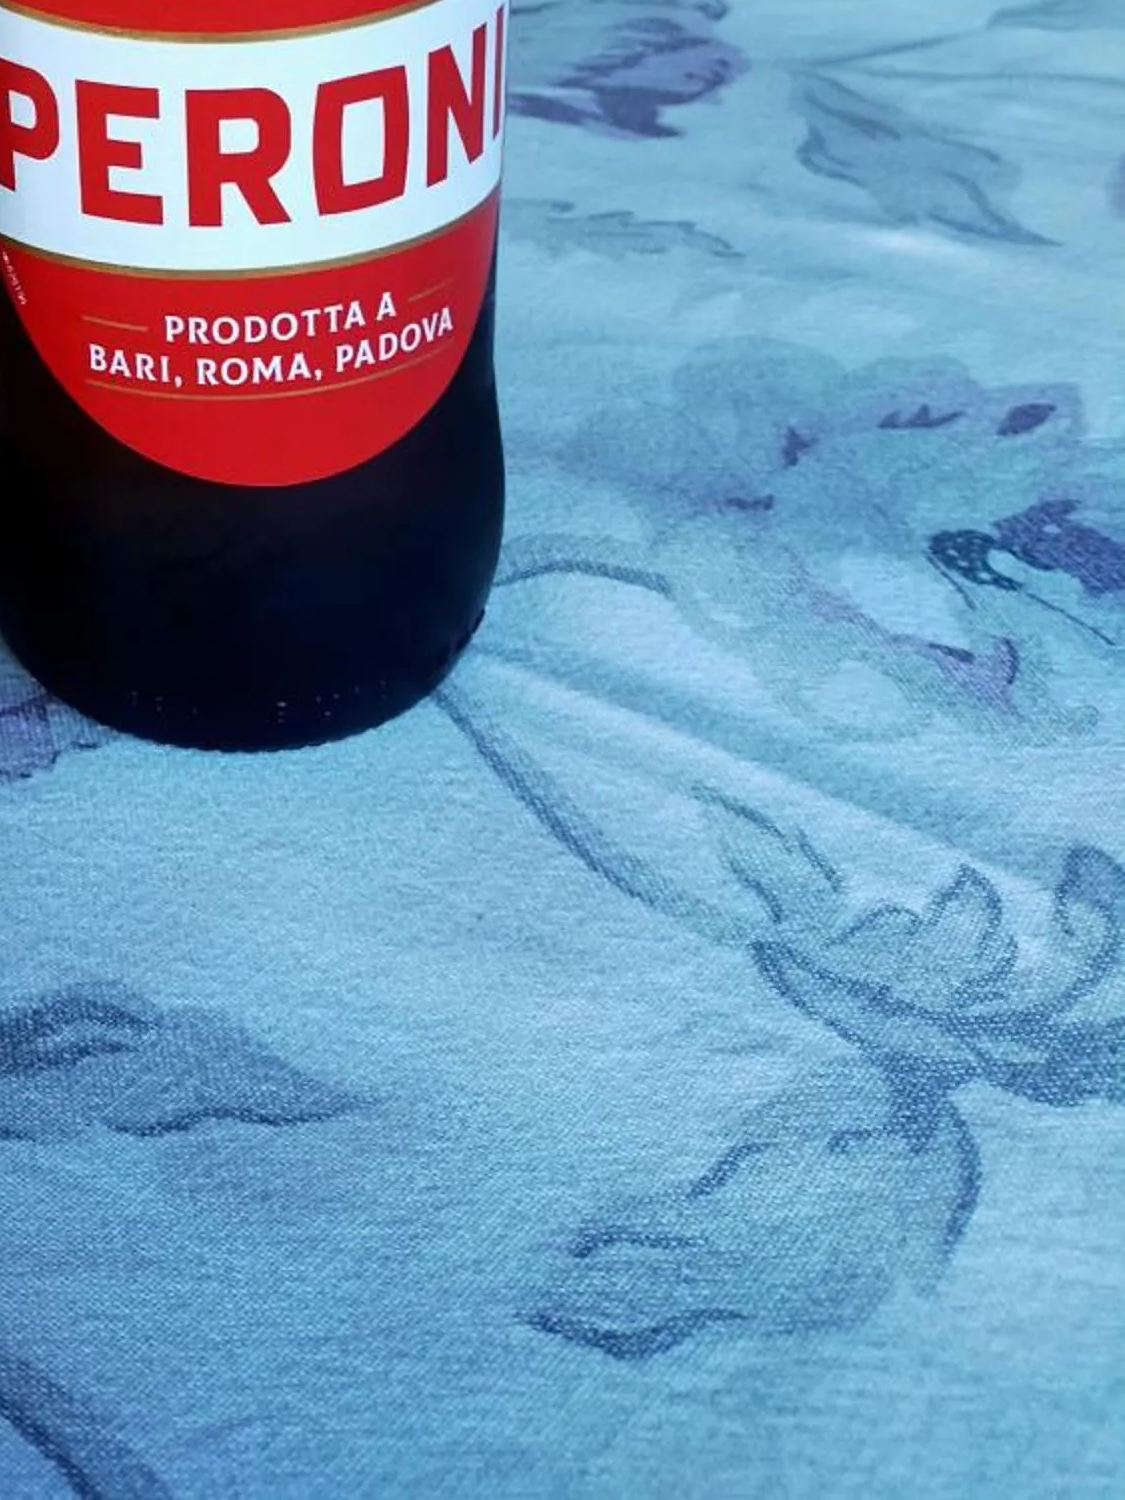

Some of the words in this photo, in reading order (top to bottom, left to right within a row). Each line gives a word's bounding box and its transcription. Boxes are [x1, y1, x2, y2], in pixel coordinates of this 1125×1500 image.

[88, 344, 184, 388] BARI,
[196, 355, 324, 386] ROMA,
[335, 306, 455, 373] PADOVA
[164, 305, 366, 345] PRODOTTA
[376, 291, 397, 318] A
